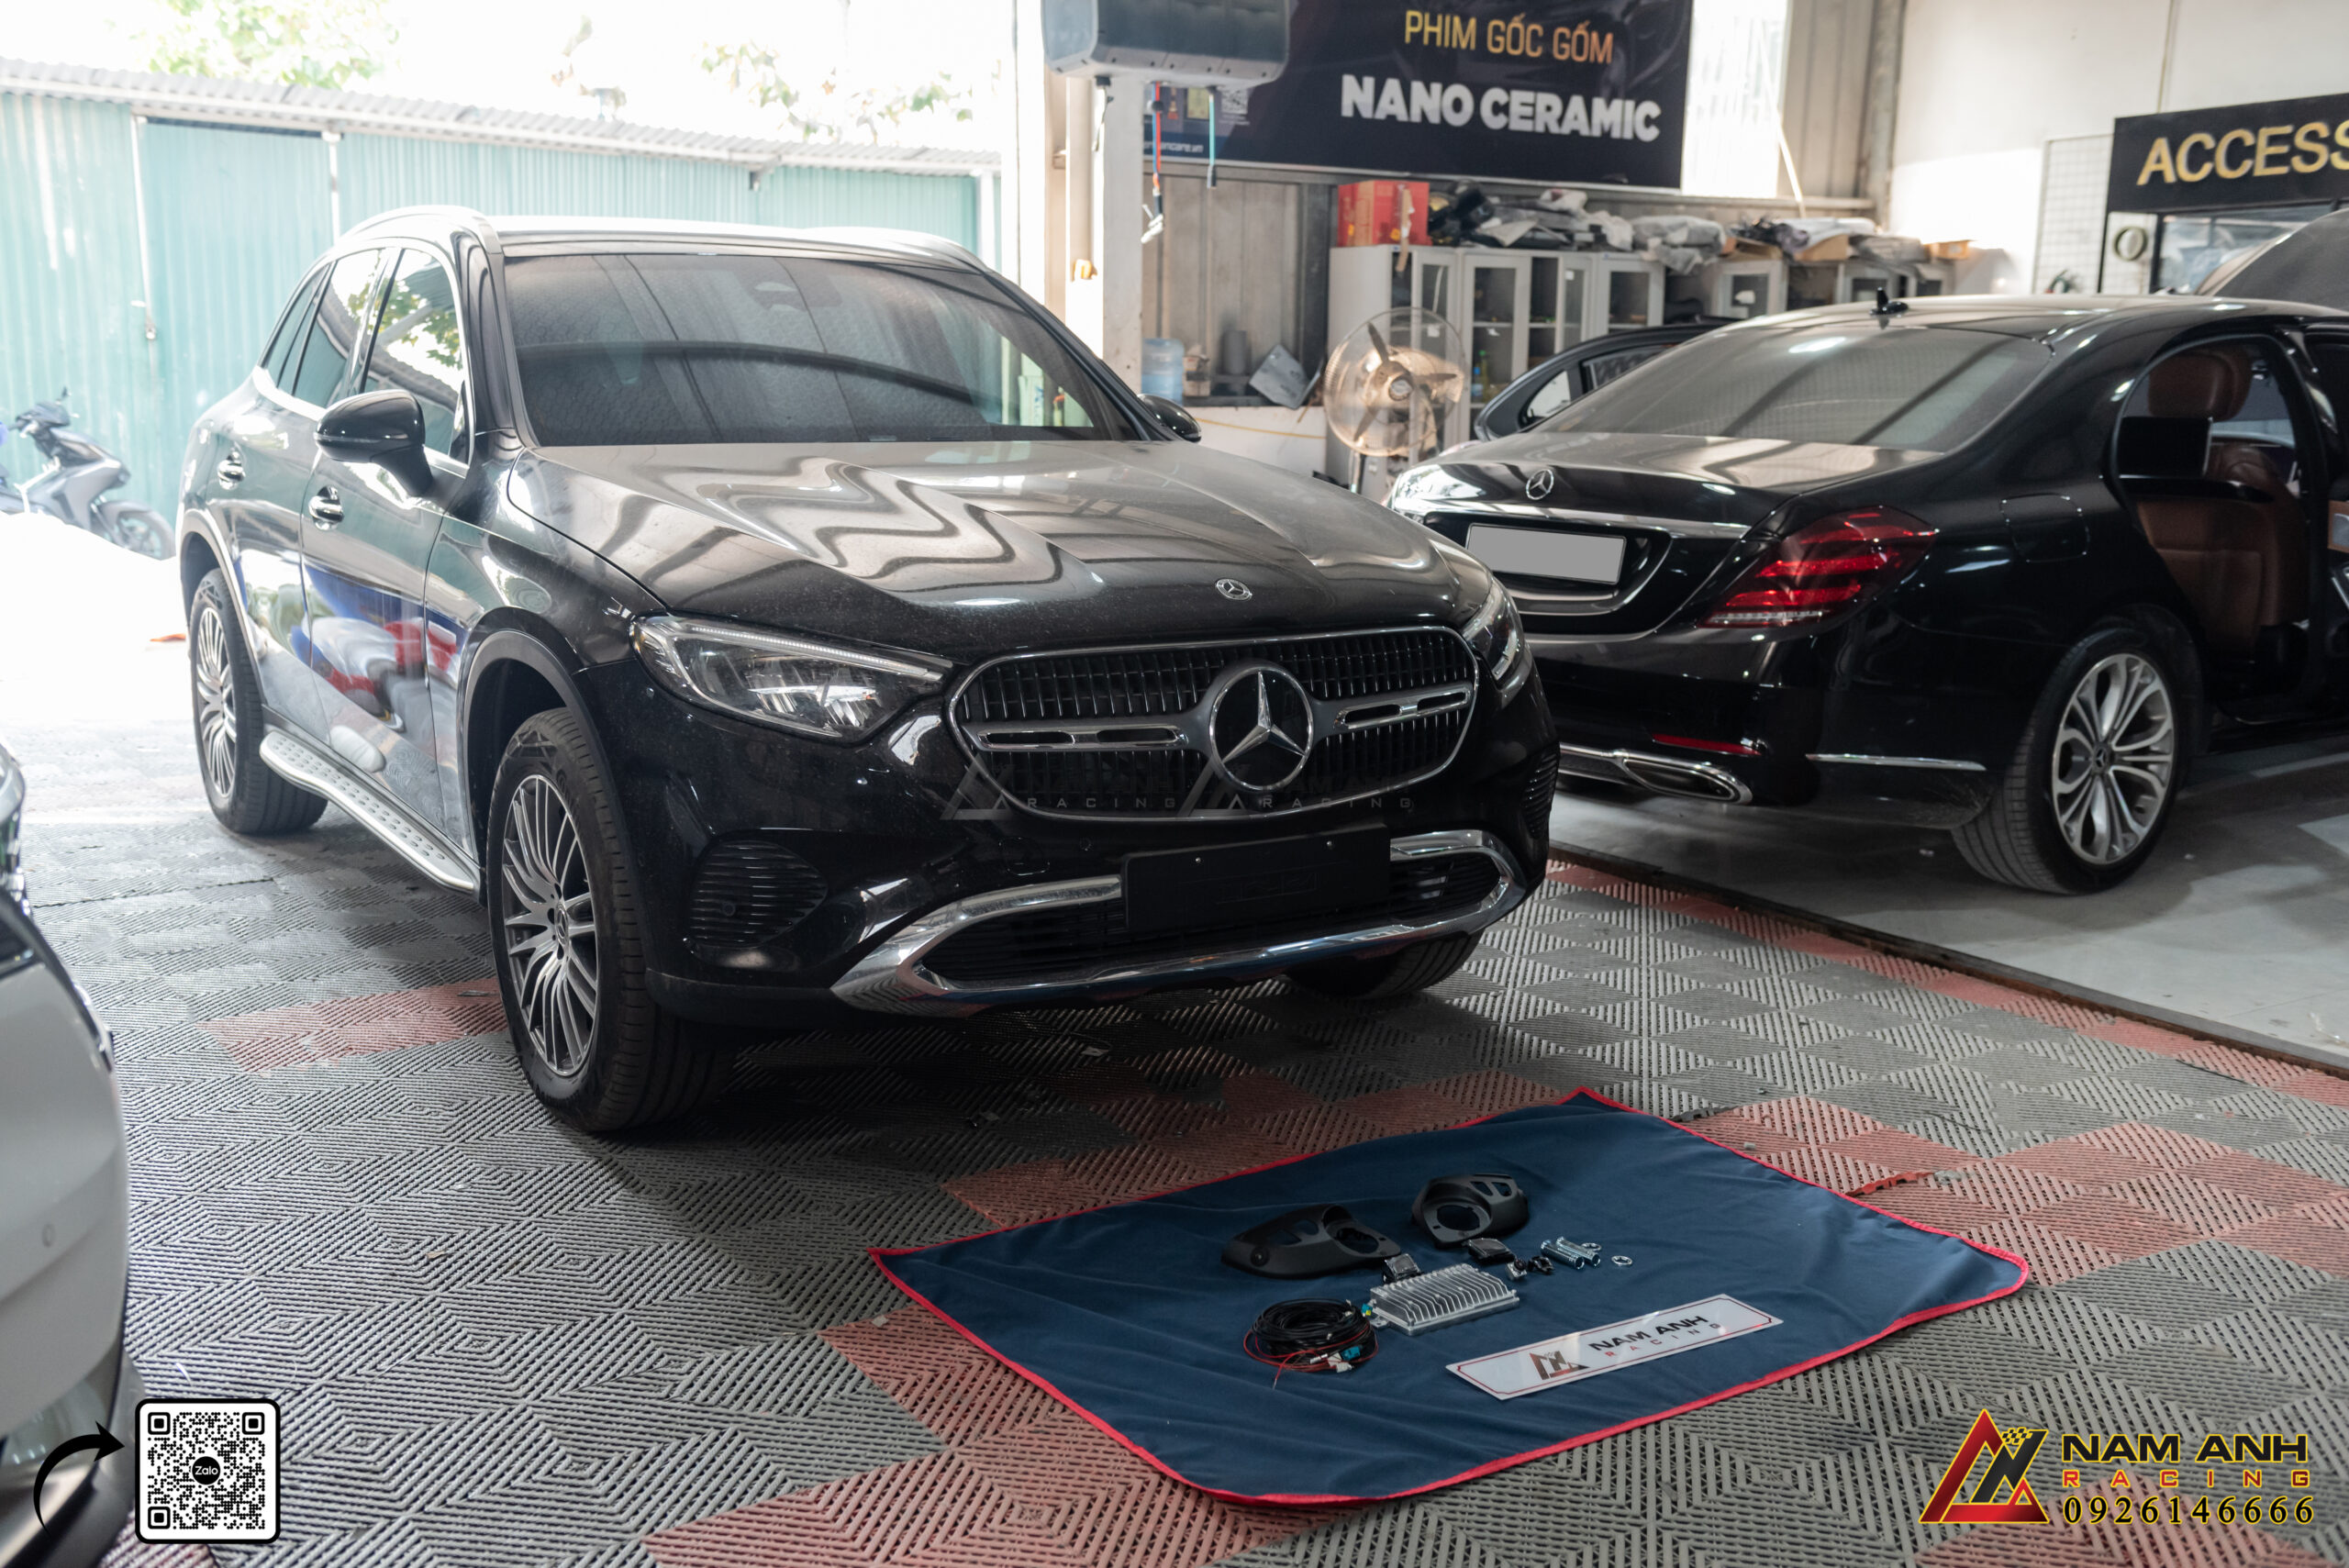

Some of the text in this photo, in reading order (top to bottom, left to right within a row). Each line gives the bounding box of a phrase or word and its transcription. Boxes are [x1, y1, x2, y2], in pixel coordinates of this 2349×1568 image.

[1404, 10, 1614, 64] PHIM GỐC GỐM
[1341, 73, 1662, 142] NANO CERAMIC
[1589, 1316, 1709, 1351] NAM ANH
[1605, 1323, 1720, 1357] RACING
